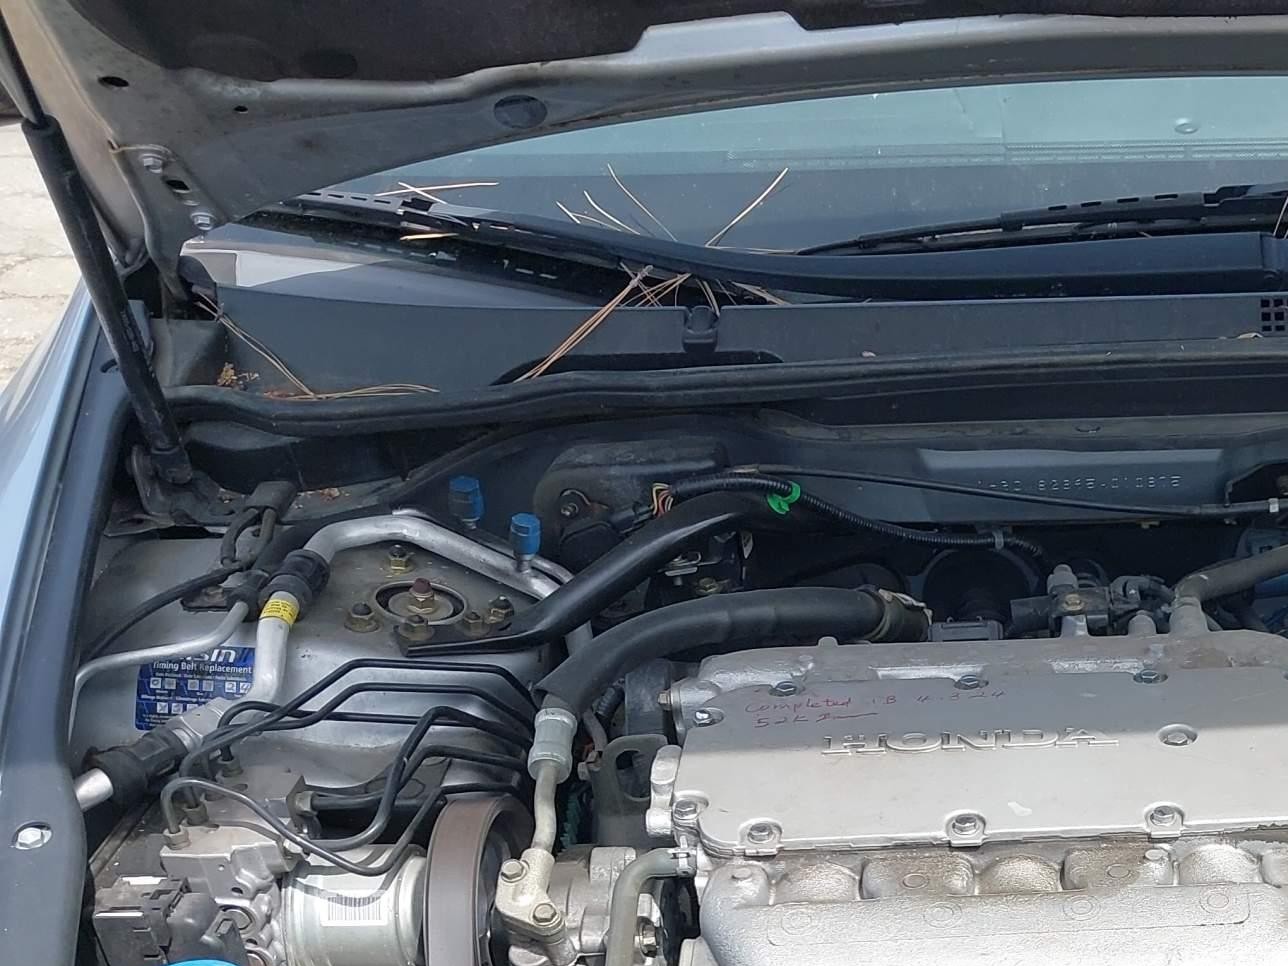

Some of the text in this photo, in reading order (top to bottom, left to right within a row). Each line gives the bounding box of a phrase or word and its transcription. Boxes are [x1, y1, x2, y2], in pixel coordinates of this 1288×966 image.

[153, 661, 252, 674] Timing Belt Replacement
[821, 728, 1119, 754] HONDA
